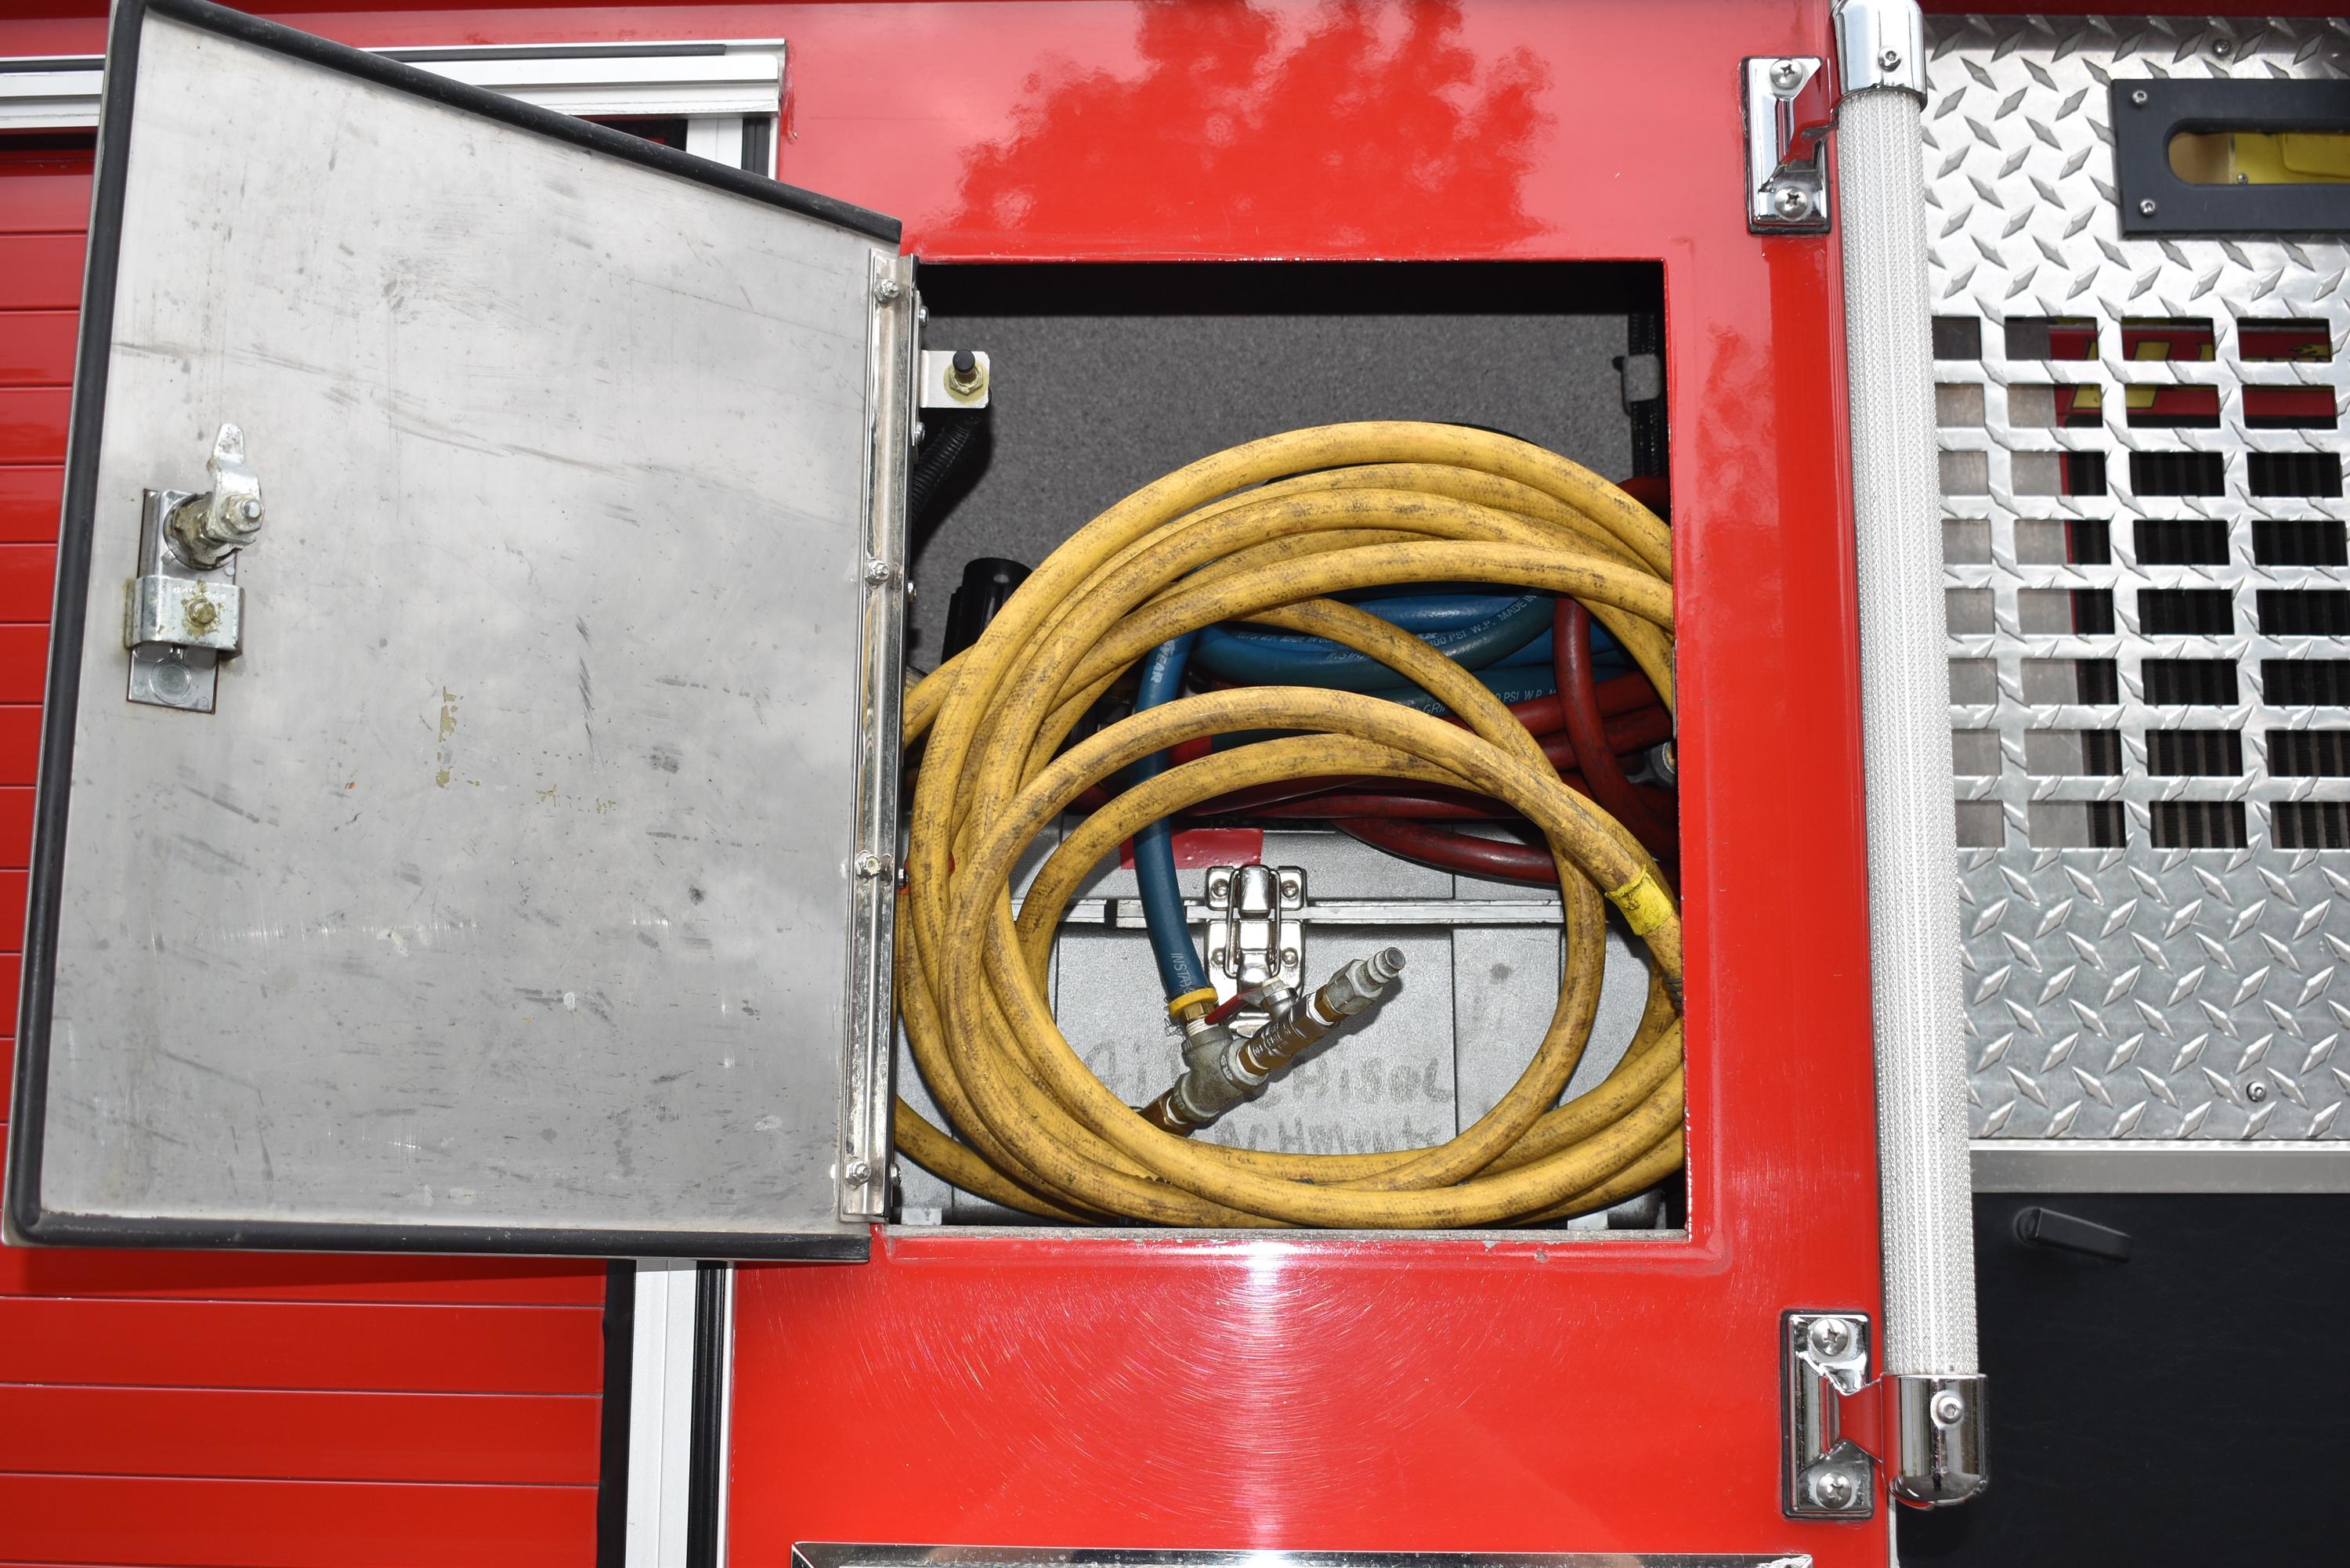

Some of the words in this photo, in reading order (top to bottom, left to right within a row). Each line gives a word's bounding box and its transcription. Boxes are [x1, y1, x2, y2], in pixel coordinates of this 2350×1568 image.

[1448, 630, 1467, 642] PSI
[1470, 620, 1496, 634] W.P.
[1497, 601, 1528, 621] MADE
[1503, 691, 1520, 703] PSI
